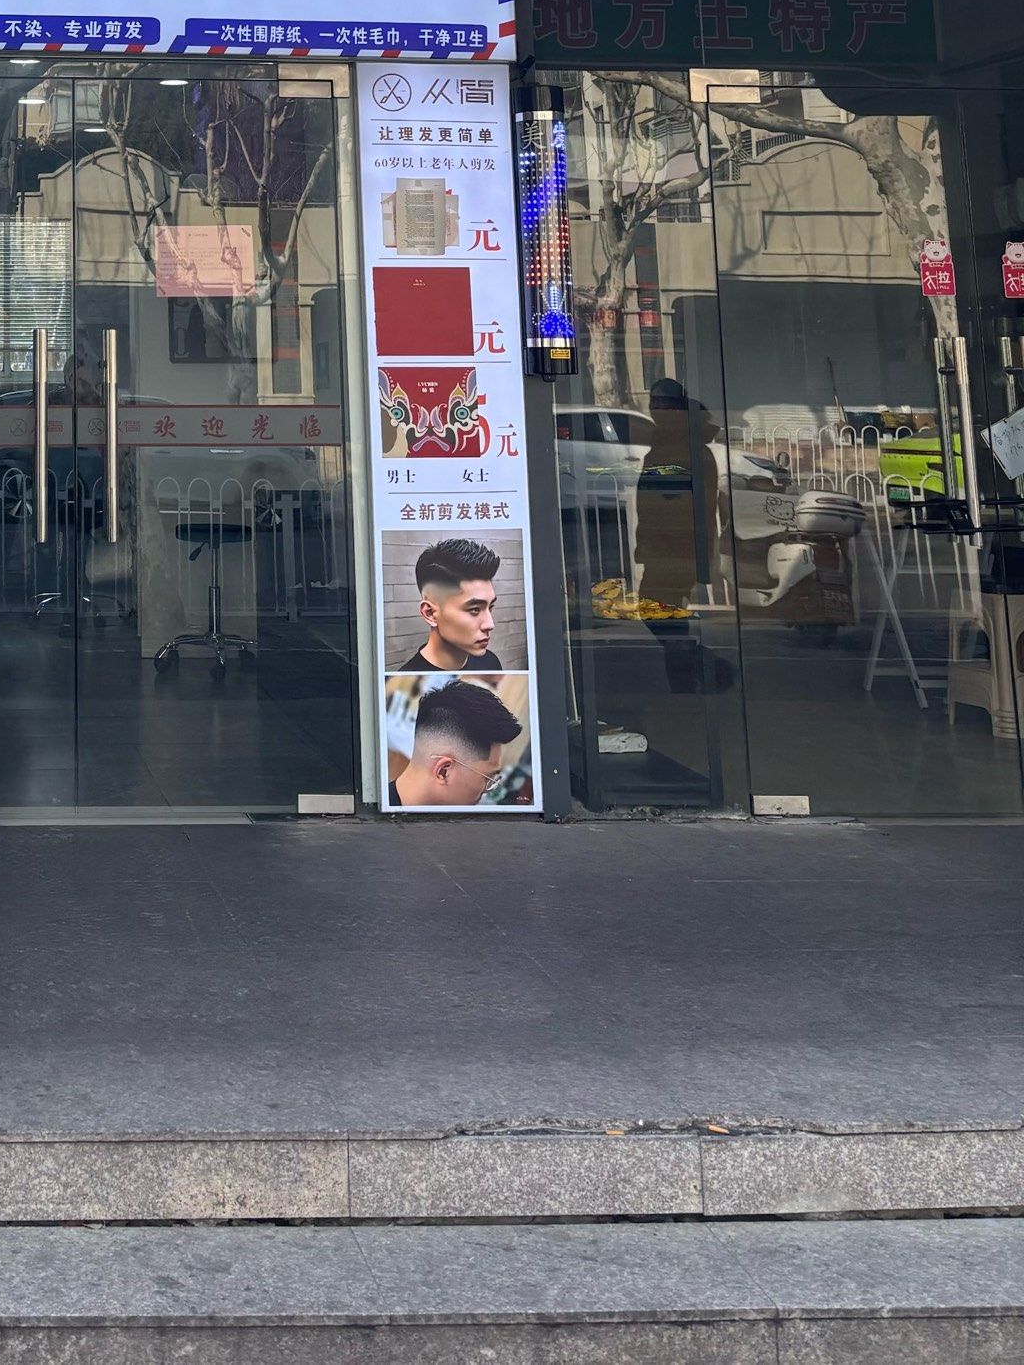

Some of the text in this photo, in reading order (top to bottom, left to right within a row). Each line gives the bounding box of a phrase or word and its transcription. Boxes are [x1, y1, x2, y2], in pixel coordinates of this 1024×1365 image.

[378, 125, 494, 144] 让理发更简单
[374, 156, 496, 171] 60岁以上老年人剪发
[466, 218, 502, 252] 元
[938, 270, 952, 284] 拉
[473, 320, 506, 354] 元
[152, 413, 322, 440] 欢迎光临
[387, 468, 489, 484] 男士 女士
[400, 501, 510, 521] 全新剪发模式
